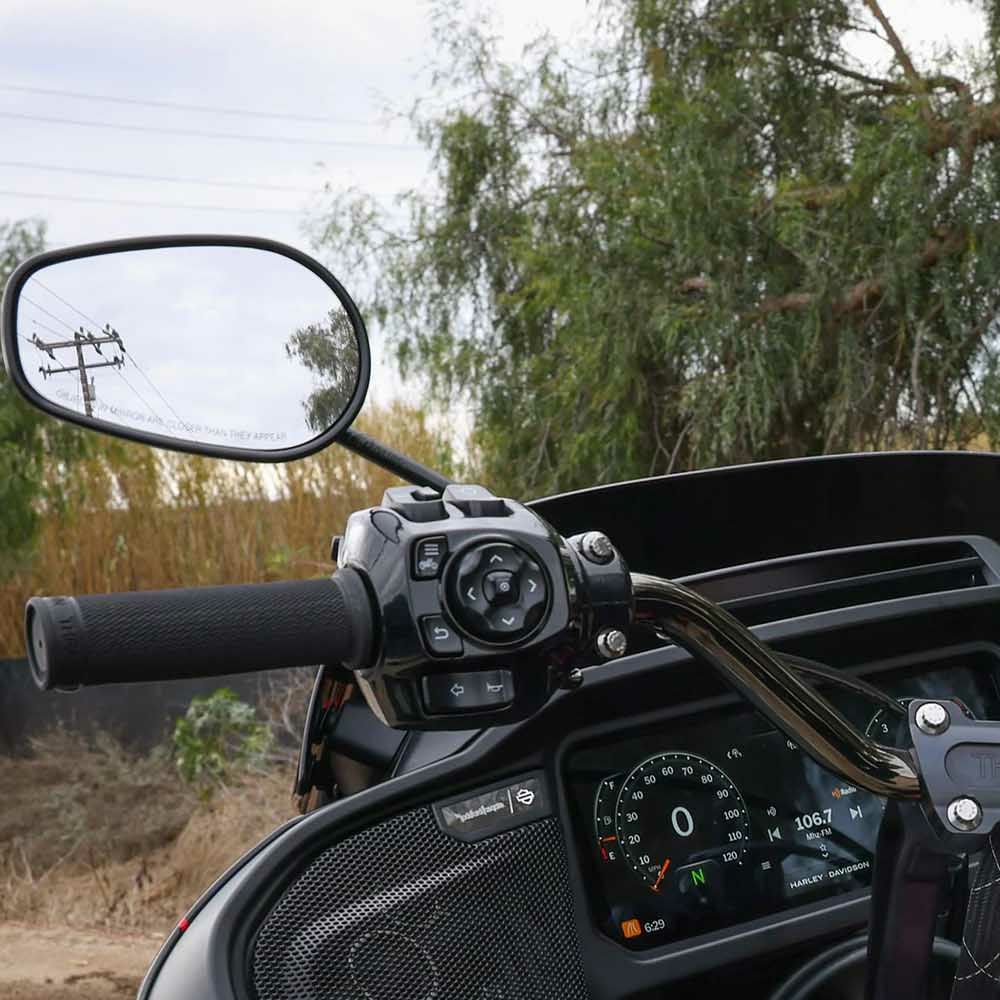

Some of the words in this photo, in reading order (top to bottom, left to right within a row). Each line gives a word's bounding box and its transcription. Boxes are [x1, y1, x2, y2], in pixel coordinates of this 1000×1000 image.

[881, 723, 889, 734] 3
[661, 765, 674, 776] 60
[682, 765, 694, 776] 70
[643, 775, 656, 785] 50
[701, 773, 713, 785] 80
[631, 790, 644, 801] 40
[716, 788, 729, 800] 90
[626, 811, 638, 823] 30
[723, 808, 740, 820] 100
[794, 807, 832, 831] 106.7
[671, 806, 694, 837] 0
[628, 834, 641, 845] 20
[728, 831, 743, 842] 110
[609, 851, 616, 860] E
[639, 855, 650, 865] 10
[722, 851, 738, 862] 120
[690, 867, 705, 886] N
[644, 919, 665, 933] 6:29
